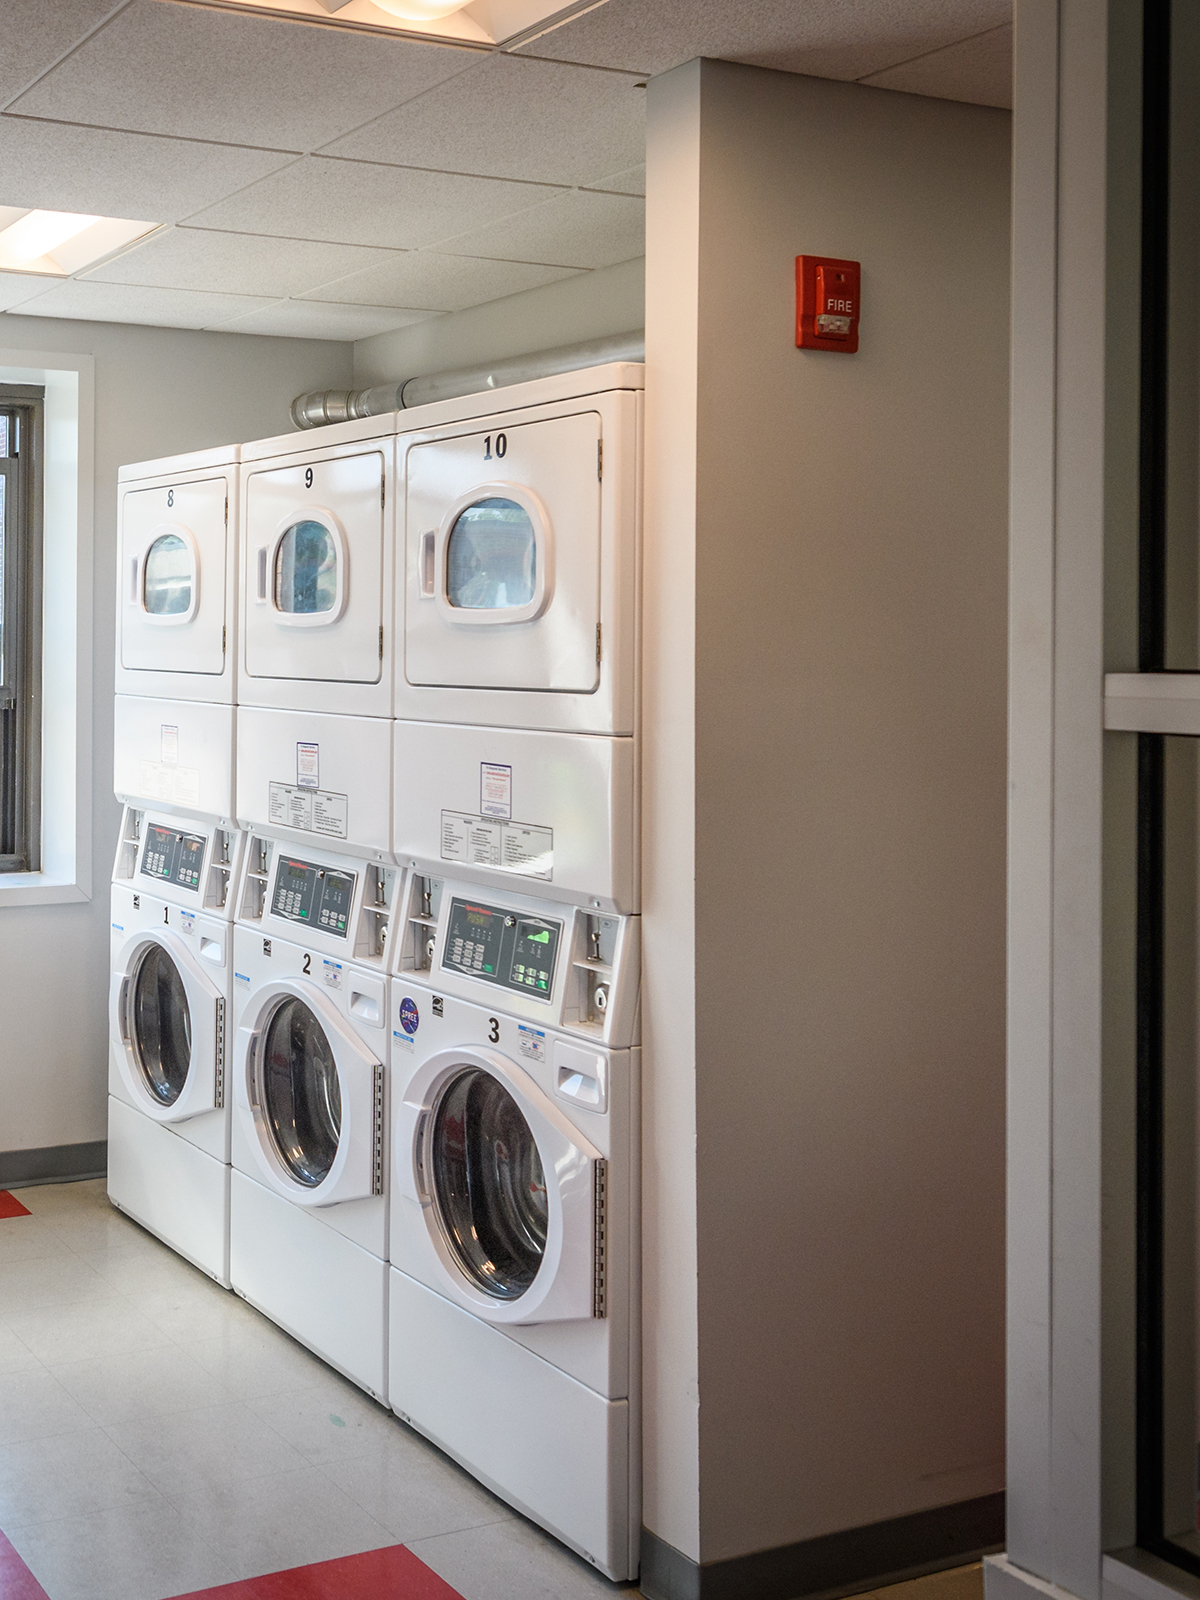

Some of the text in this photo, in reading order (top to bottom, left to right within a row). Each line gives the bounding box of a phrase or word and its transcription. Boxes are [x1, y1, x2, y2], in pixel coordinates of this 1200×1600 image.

[827, 299, 852, 312] FIRE
[483, 433, 508, 460] 10
[305, 467, 314, 488] 9
[167, 489, 174, 508] 8
[163, 906, 169, 925] 1
[302, 952, 312, 976] 2
[401, 1009, 417, 1023] SPREE
[488, 1017, 500, 1044] 3
